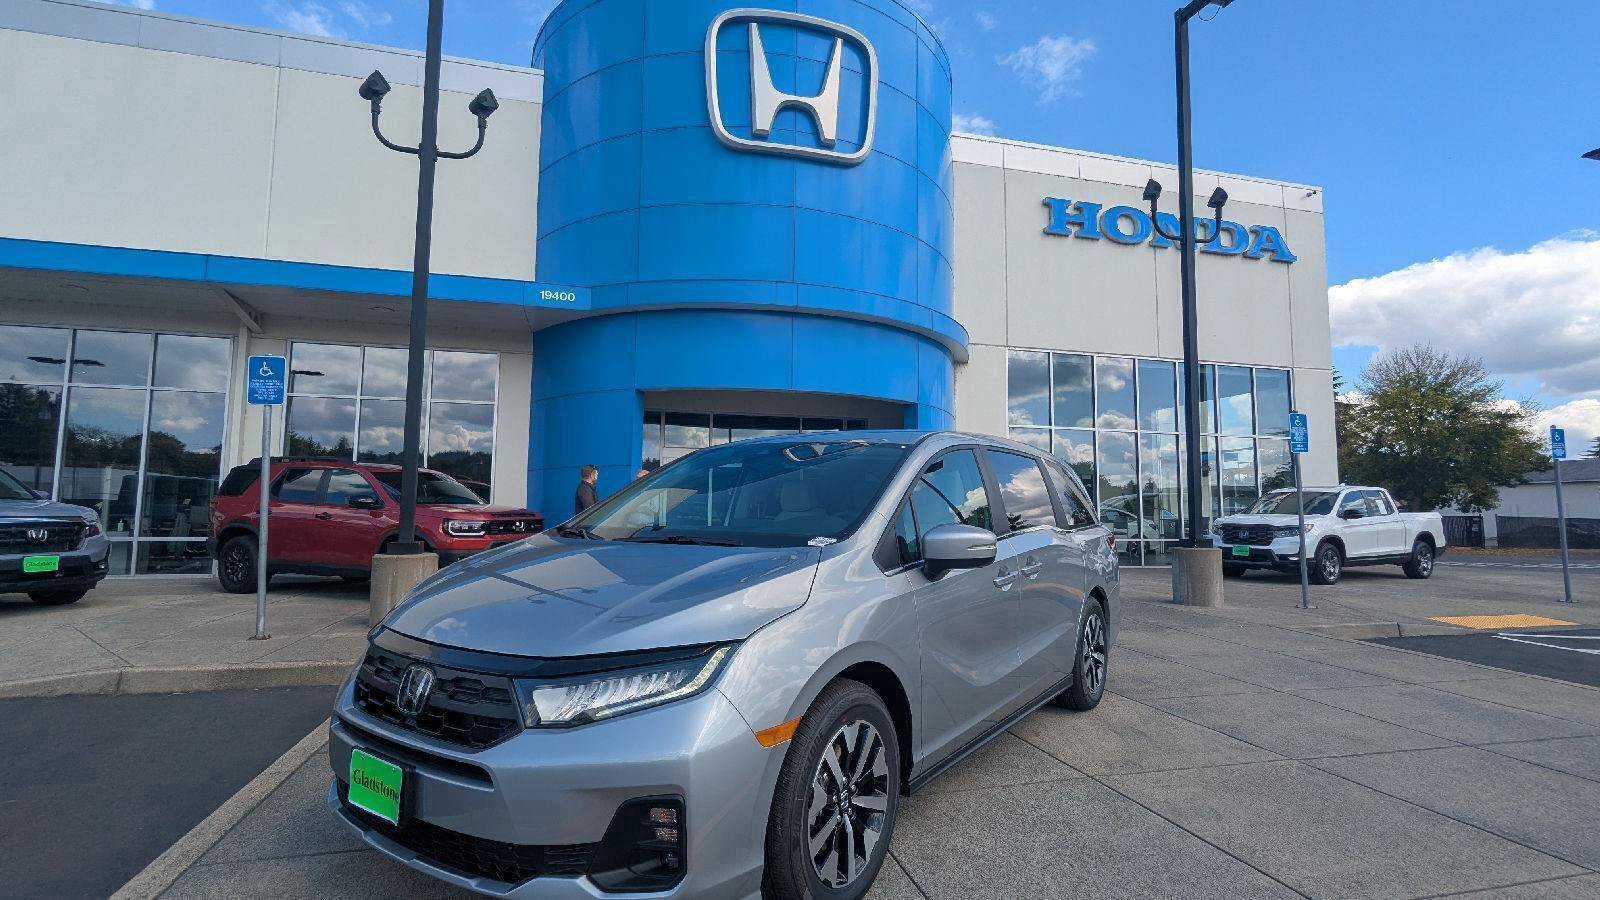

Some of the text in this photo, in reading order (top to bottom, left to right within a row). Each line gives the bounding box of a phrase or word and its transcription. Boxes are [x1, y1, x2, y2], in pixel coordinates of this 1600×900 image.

[1042, 196, 1297, 263] HONDA
[539, 290, 576, 302] 19400
[352, 768, 400, 803] Gladstone
